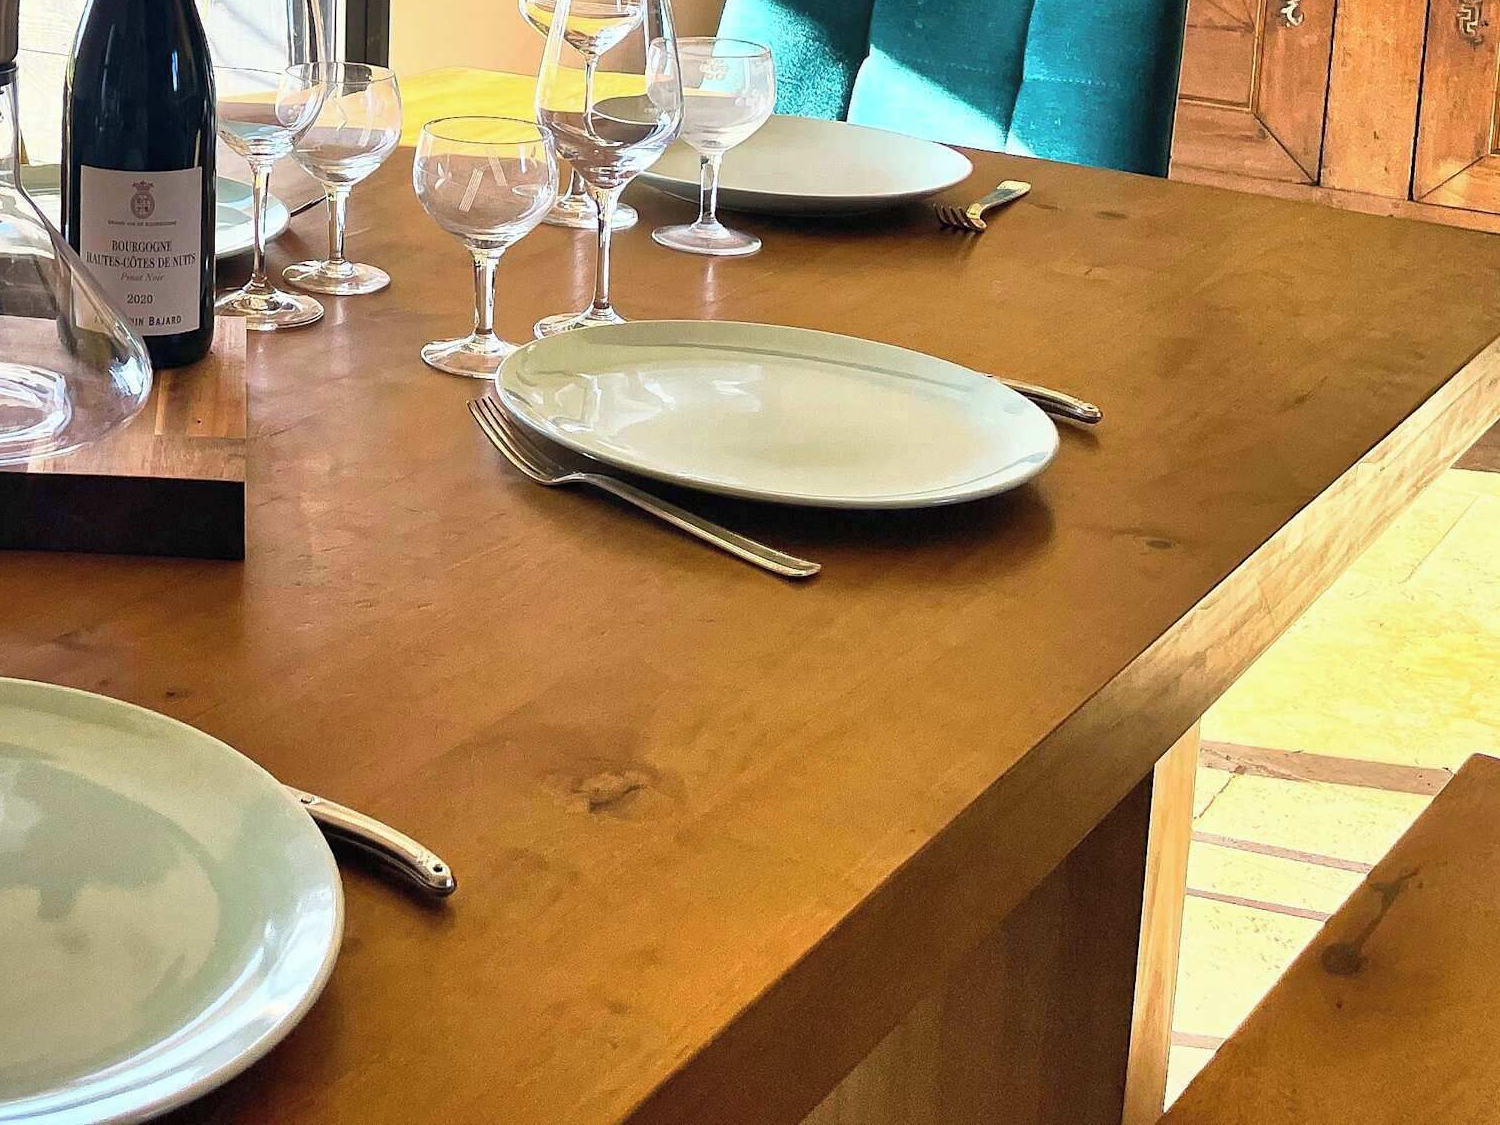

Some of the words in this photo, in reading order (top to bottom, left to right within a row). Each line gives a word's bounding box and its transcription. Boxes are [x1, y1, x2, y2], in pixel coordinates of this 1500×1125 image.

[112, 240, 172, 252] BOURGOGNE
[86, 251, 155, 268] HAUTES-CÔTES
[158, 256, 170, 268] DE
[172, 253, 196, 266] NUITS
[127, 294, 153, 304] 2020
[149, 315, 182, 326] BAJARD
